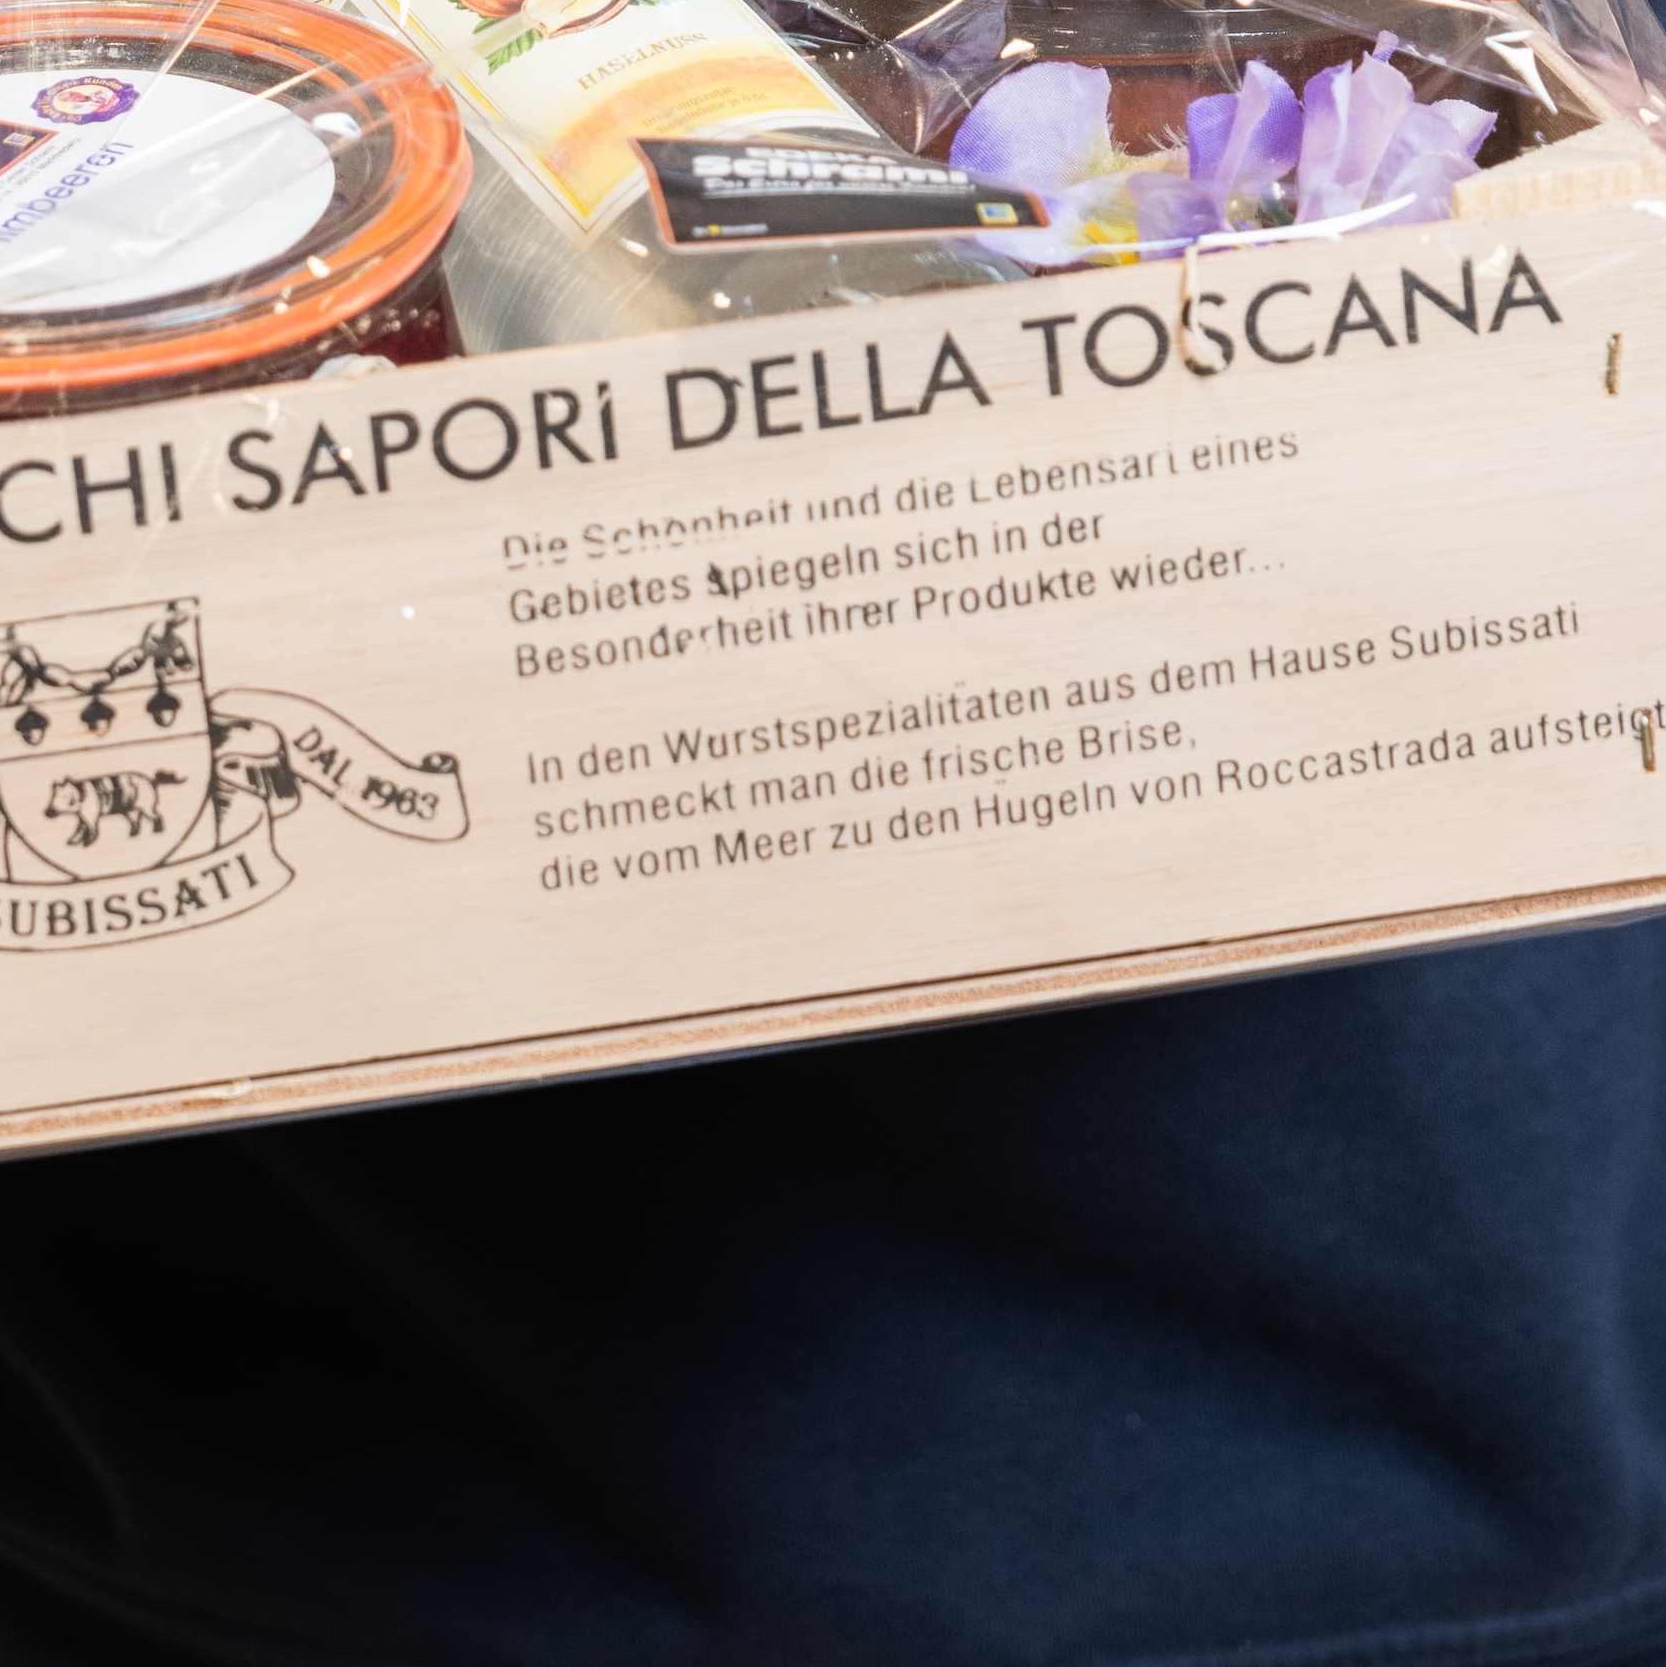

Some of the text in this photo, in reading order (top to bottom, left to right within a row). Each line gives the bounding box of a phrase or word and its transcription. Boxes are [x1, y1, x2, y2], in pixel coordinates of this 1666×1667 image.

[576, 32, 710, 91] HASELNUSS
[692, 154, 970, 185] Schraml
[227, 381, 620, 513] SAPORI
[665, 331, 993, 451] DELLA
[1021, 247, 1564, 397] TOSCANA
[895, 475, 955, 514] die
[1190, 431, 1300, 472] eines
[509, 569, 693, 625] Gebietes
[893, 526, 980, 570] sich
[992, 520, 1028, 555] in
[1041, 512, 1107, 549] der
[515, 545, 1287, 679] Besonderheit ihrer Produkte wieder...
[527, 600, 1581, 786] In den Wurstspezialitäten aus dem Hause Subissati
[292, 724, 442, 821] DAL 1963
[534, 717, 1198, 839] schmeckt man die frische Brise,
[540, 853, 601, 893] die
[613, 842, 701, 883] vom
[713, 824, 819, 869] Meer
[829, 818, 875, 853] zu
[888, 805, 961, 842] den
[974, 779, 1117, 831] Hügeln
[1130, 769, 1203, 808] von
[1215, 729, 1477, 796] Roccastrada
